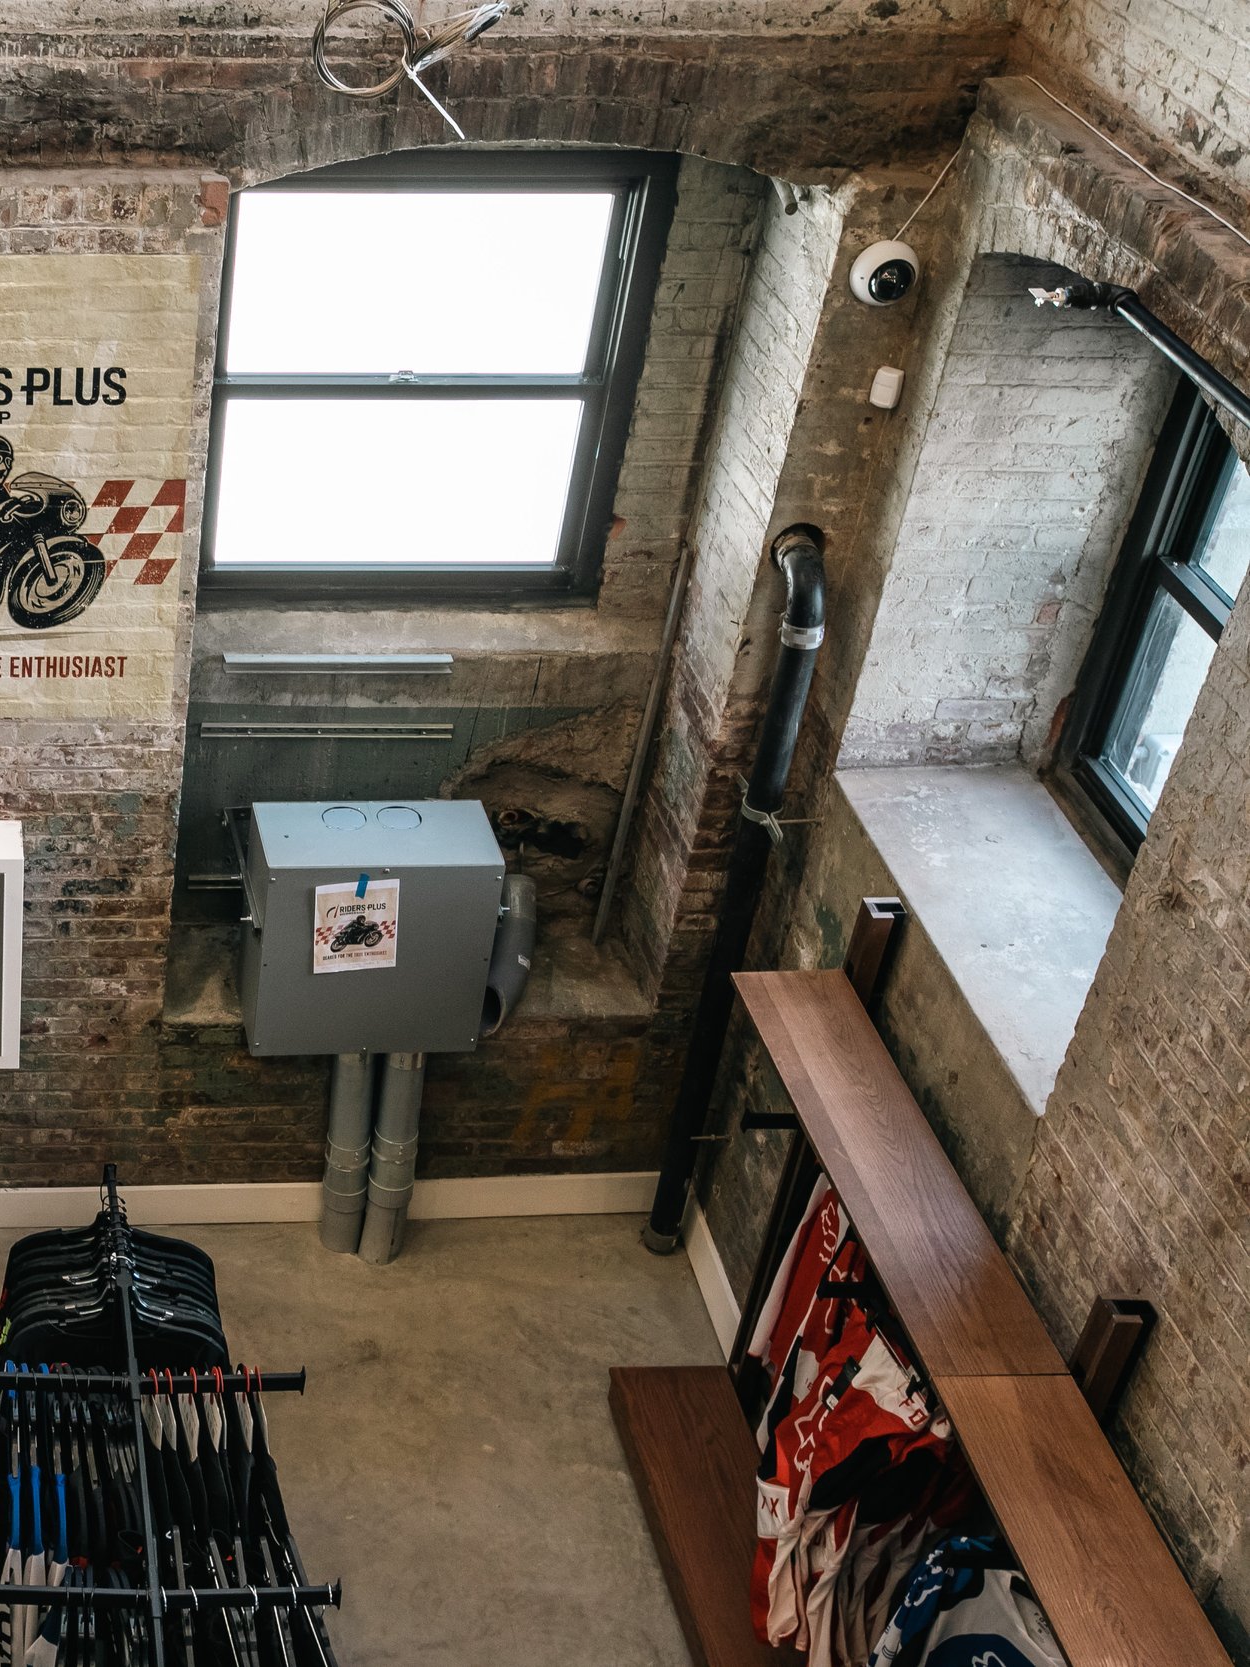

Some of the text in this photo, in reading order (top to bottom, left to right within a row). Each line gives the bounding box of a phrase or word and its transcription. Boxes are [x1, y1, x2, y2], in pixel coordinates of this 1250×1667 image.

[20, 366, 127, 406] PLUS
[10, 655, 128, 678] ENTHUSIAST
[340, 904, 366, 912] RIDERS
